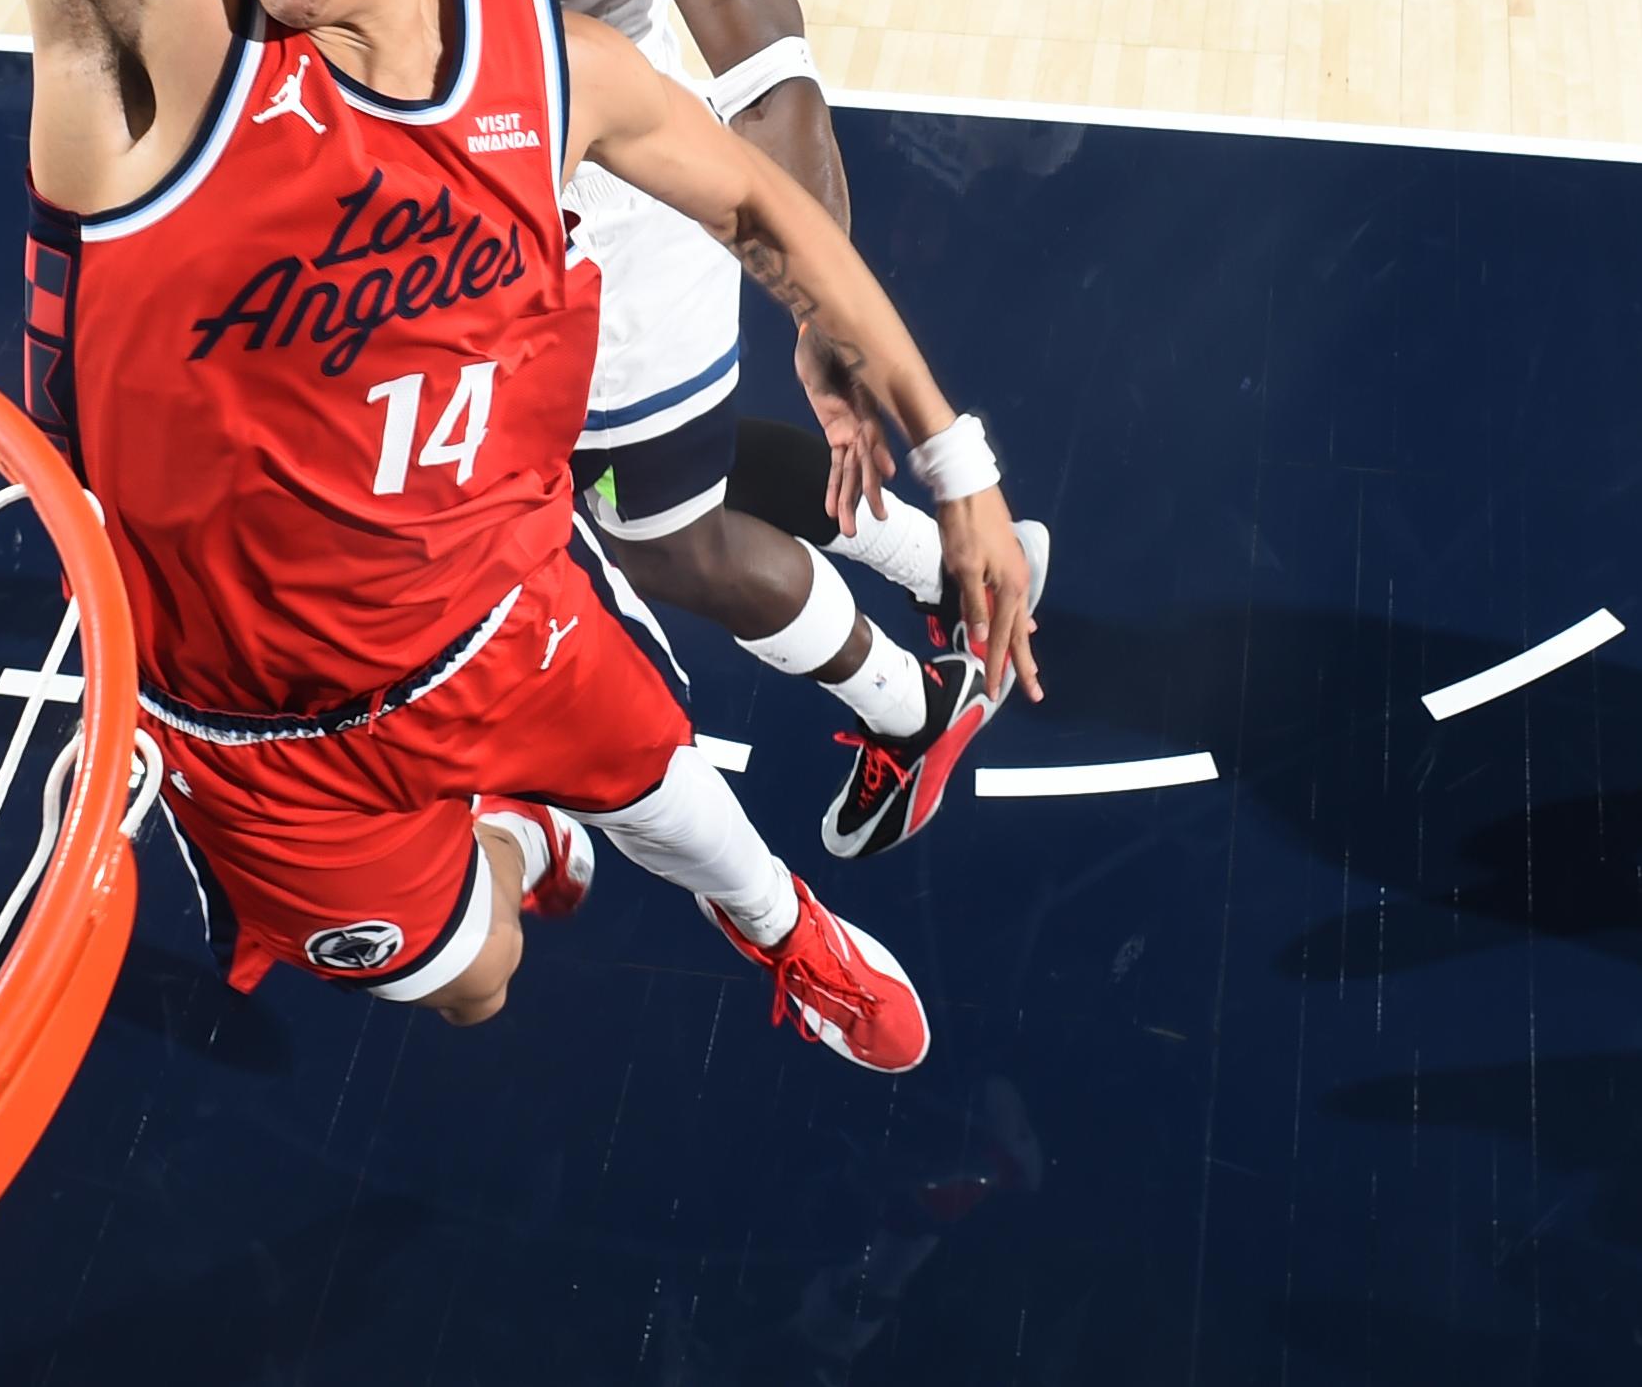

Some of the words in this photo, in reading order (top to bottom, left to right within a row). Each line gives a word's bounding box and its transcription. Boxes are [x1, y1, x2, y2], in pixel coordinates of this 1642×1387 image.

[467, 130, 541, 153] RWANDA
[474, 113, 522, 133] VISIT
[312, 166, 458, 269] Los
[186, 214, 526, 377] Angeles
[366, 361, 499, 495] 14
